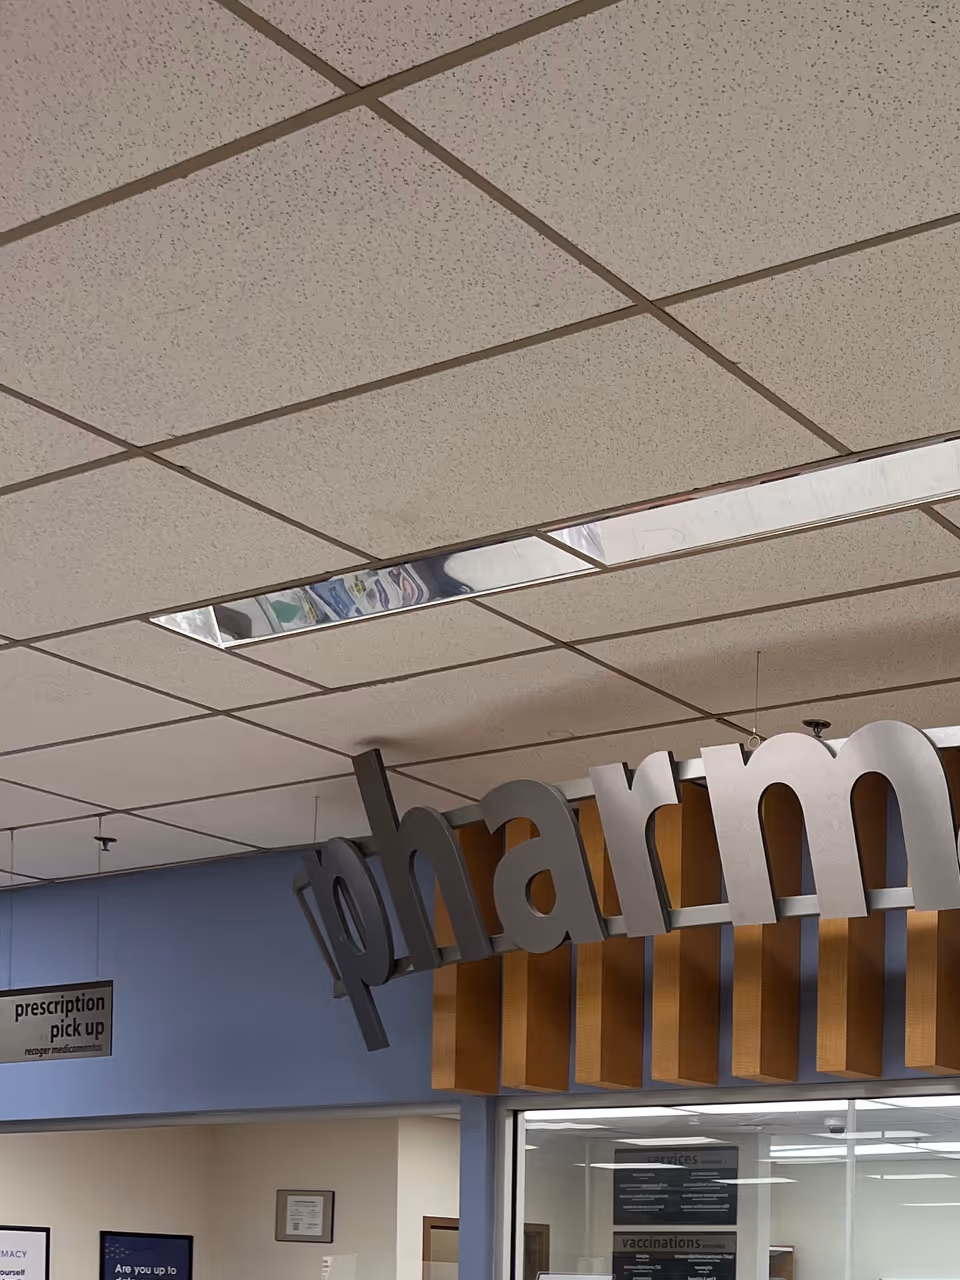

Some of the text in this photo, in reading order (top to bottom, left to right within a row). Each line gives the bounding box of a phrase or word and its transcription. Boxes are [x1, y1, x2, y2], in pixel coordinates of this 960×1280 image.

[15, 993, 105, 1022] prescription
[50, 1018, 105, 1043] pick up
[25, 1047, 50, 1057] recoger
[622, 1236, 701, 1249] vaccinations
[0, 1250, 27, 1258] MACY
[114, 1264, 177, 1275] Are you up to
